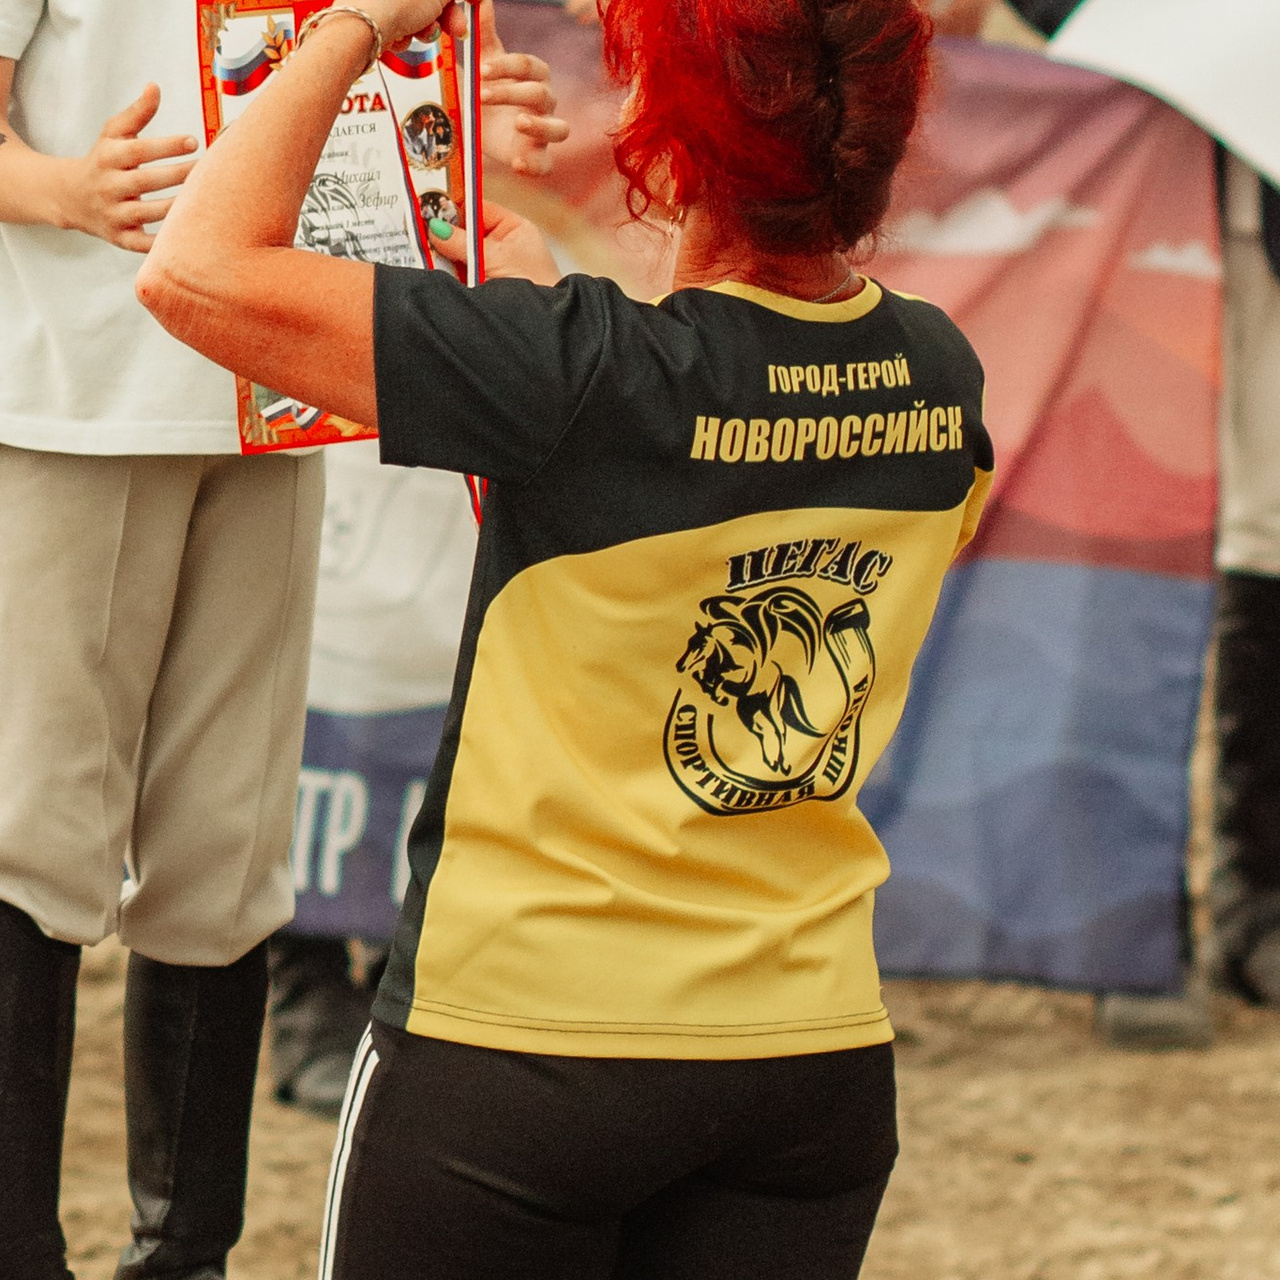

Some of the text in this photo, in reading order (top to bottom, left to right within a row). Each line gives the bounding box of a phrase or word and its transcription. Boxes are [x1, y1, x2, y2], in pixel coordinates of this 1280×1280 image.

[340, 92, 387, 114] ОТА
[329, 123, 376, 138] ДАЕТСЯ
[358, 191, 399, 209] Зефир
[768, 353, 911, 397] ГОРОД-ГЕРОЙ
[690, 400, 963, 463] НОВОРОССИЙСК
[725, 538, 893, 594] ПЕГАС
[673, 674, 869, 808] СПОРТИВНАЯ ШКОЛА
[293, 770, 368, 895] ТР
